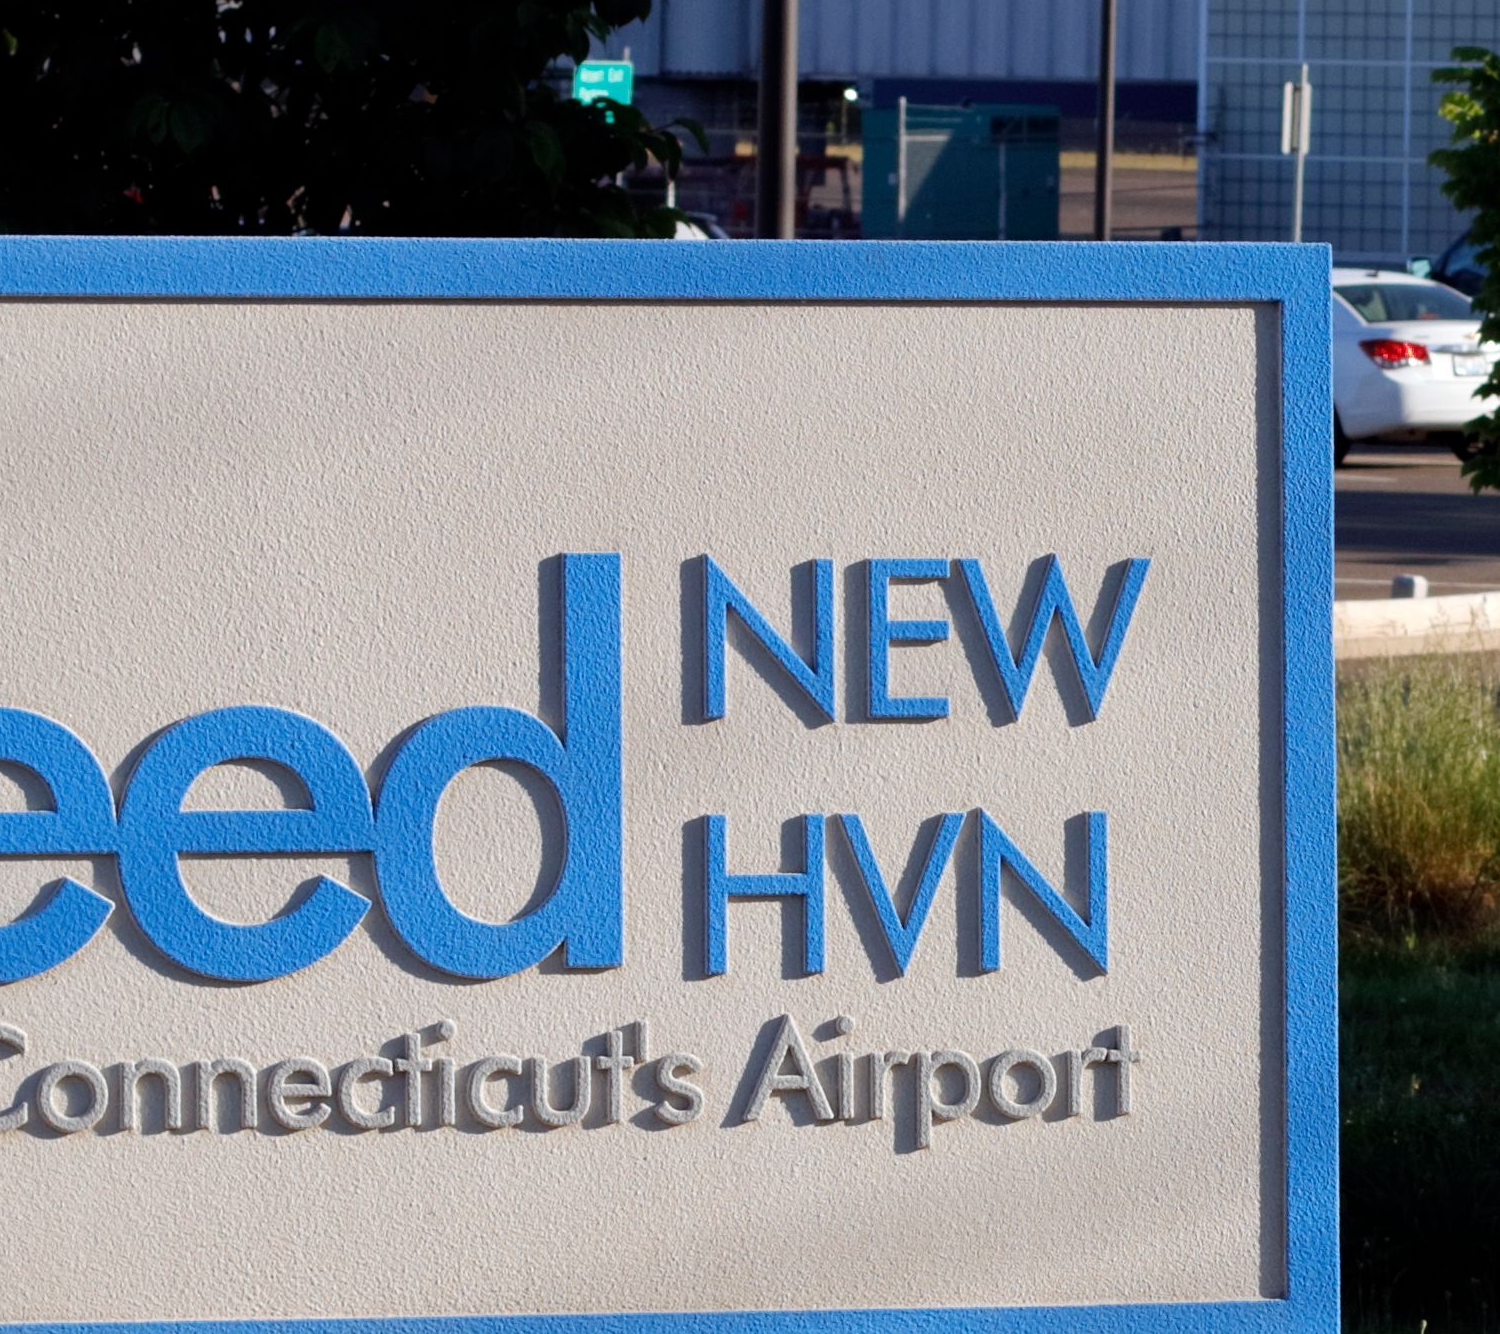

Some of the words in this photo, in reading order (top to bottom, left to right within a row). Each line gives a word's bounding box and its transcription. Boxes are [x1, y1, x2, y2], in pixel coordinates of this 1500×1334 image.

[702, 552, 1152, 723] NEW
[703, 807, 1108, 979] HVN
[743, 1013, 1141, 1150] Airport
